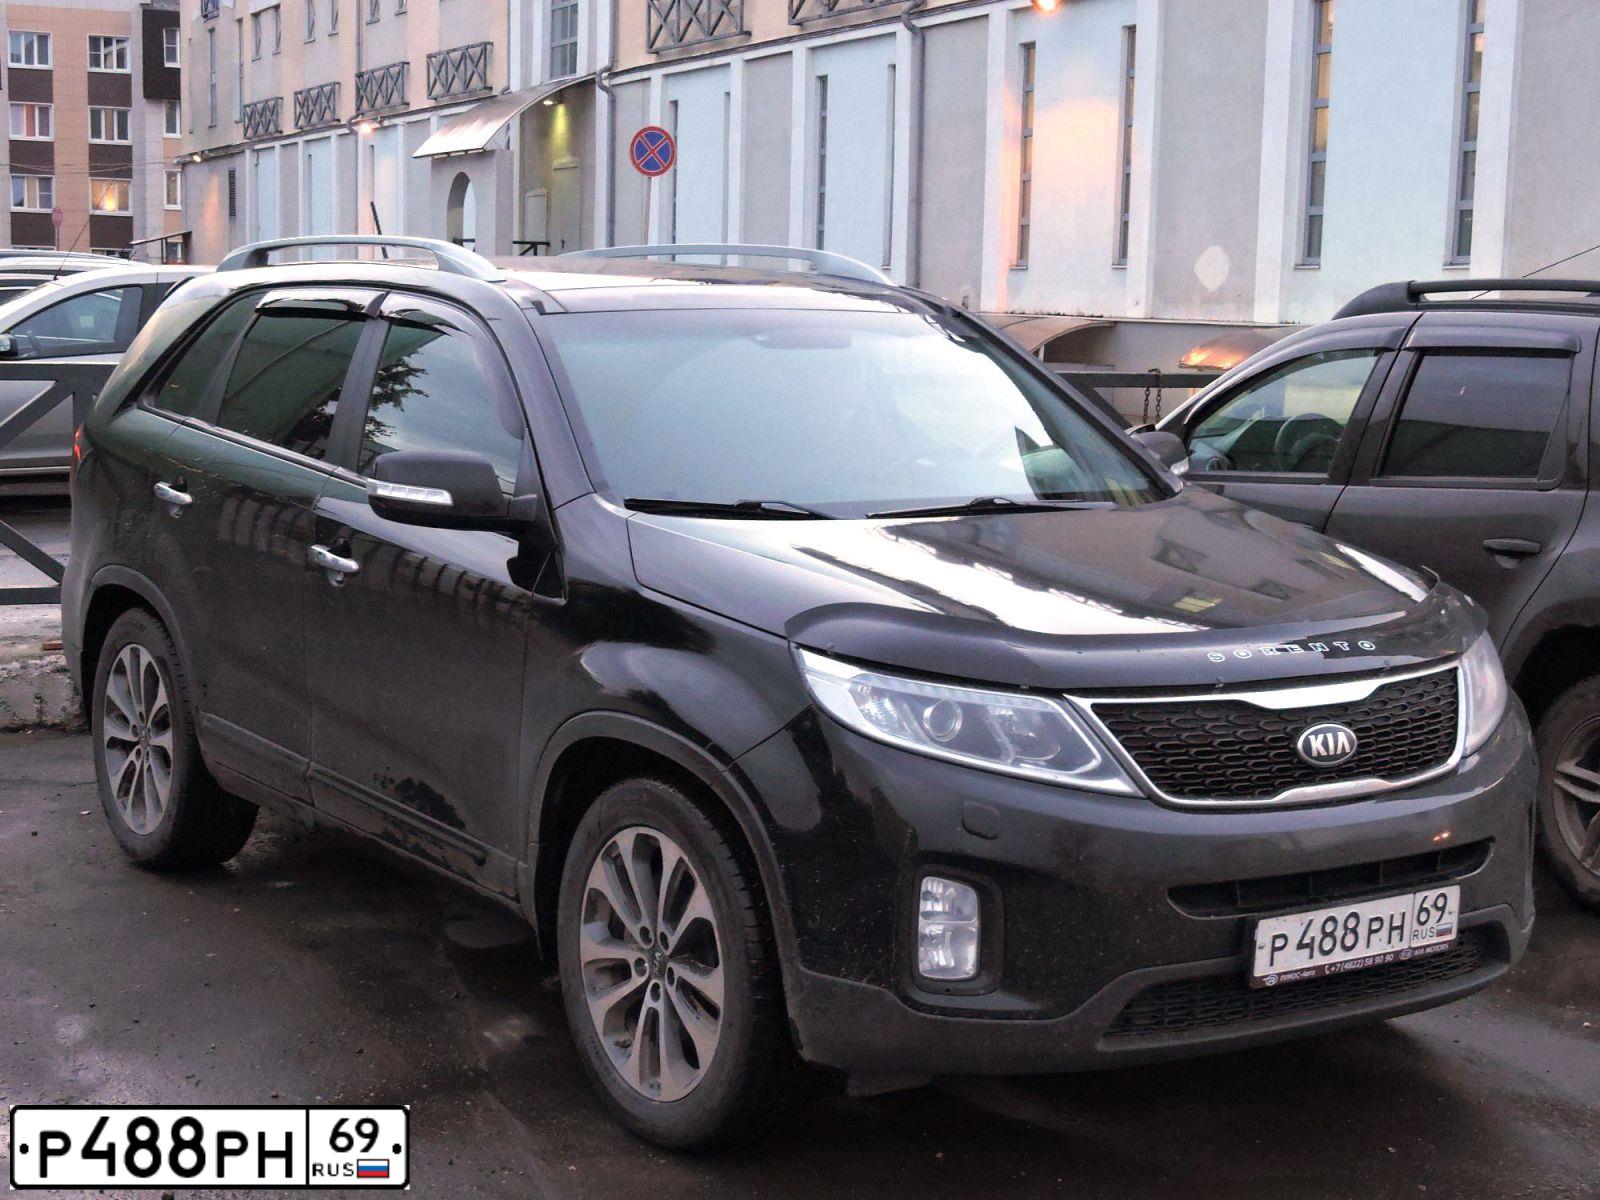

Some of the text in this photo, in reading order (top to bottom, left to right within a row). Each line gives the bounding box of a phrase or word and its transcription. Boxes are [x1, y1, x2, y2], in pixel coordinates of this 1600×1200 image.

[1207, 640, 1376, 663] SORENTO
[1307, 731, 1351, 757] KIA
[1416, 892, 1448, 926] 69
[1412, 926, 1436, 941] RUS
